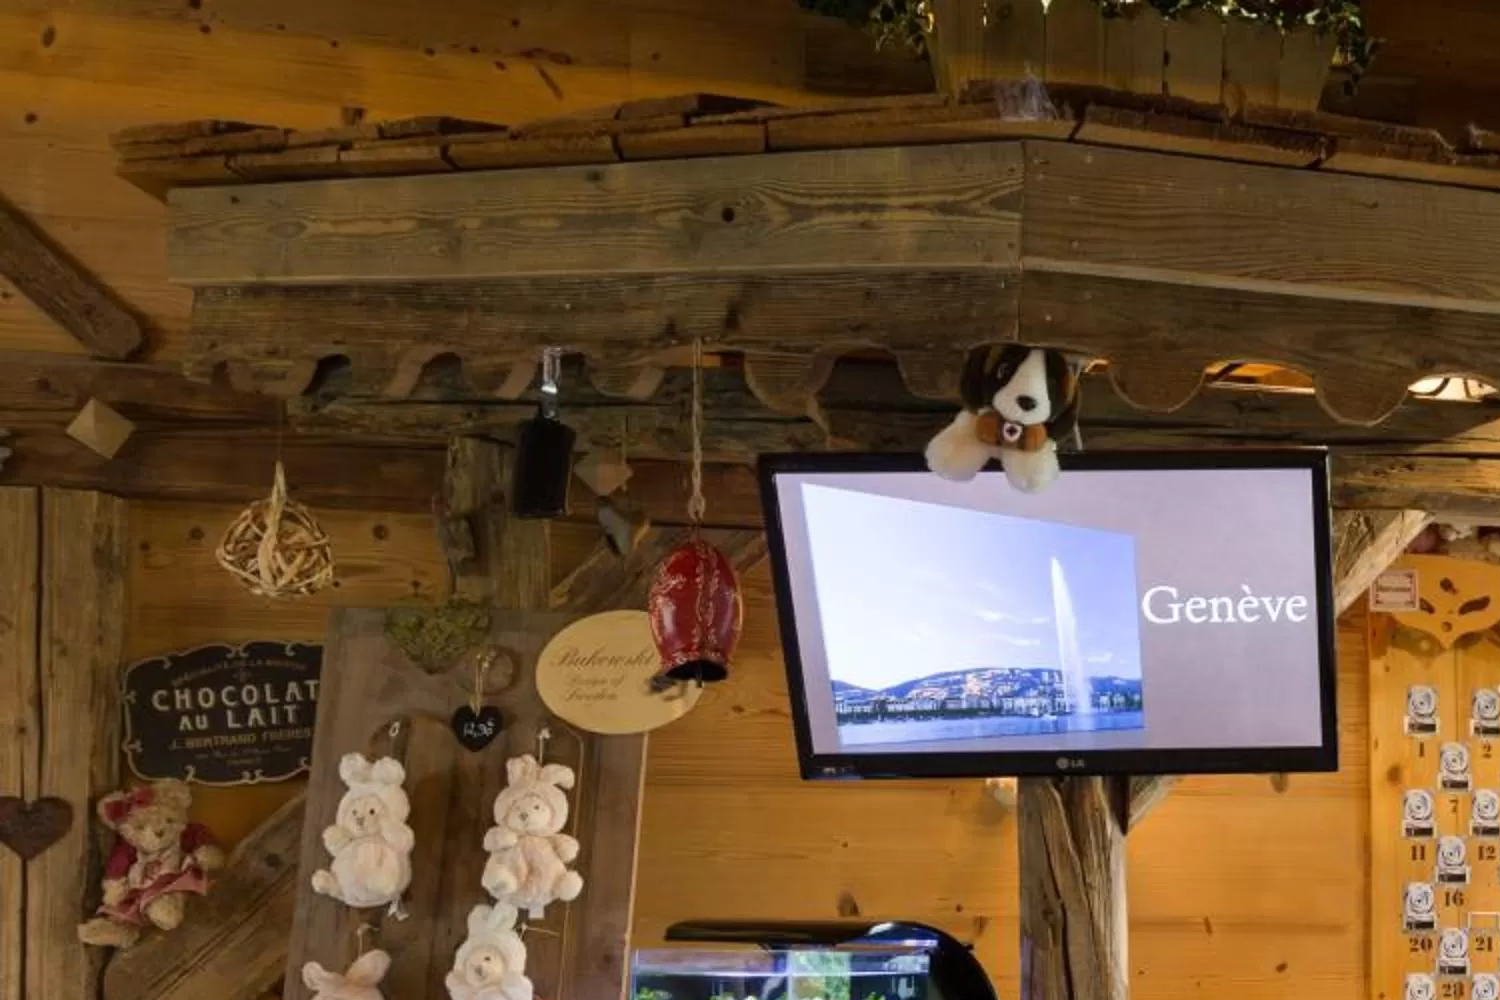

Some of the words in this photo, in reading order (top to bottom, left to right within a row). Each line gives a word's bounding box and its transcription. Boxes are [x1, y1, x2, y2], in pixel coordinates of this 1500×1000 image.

[1141, 584, 1309, 625] Genève
[151, 679, 321, 712] CHOCOLAT
[178, 713, 210, 732] AU
[225, 703, 298, 729] LAIT
[1417, 741, 1425, 759] 1
[1480, 743, 1493, 760] 2
[1447, 798, 1460, 815] 7
[1410, 844, 1427, 861] 11
[1477, 845, 1497, 861] 12
[1443, 889, 1465, 907] 16
[1408, 936, 1433, 952] 20
[1474, 935, 1494, 952] 21
